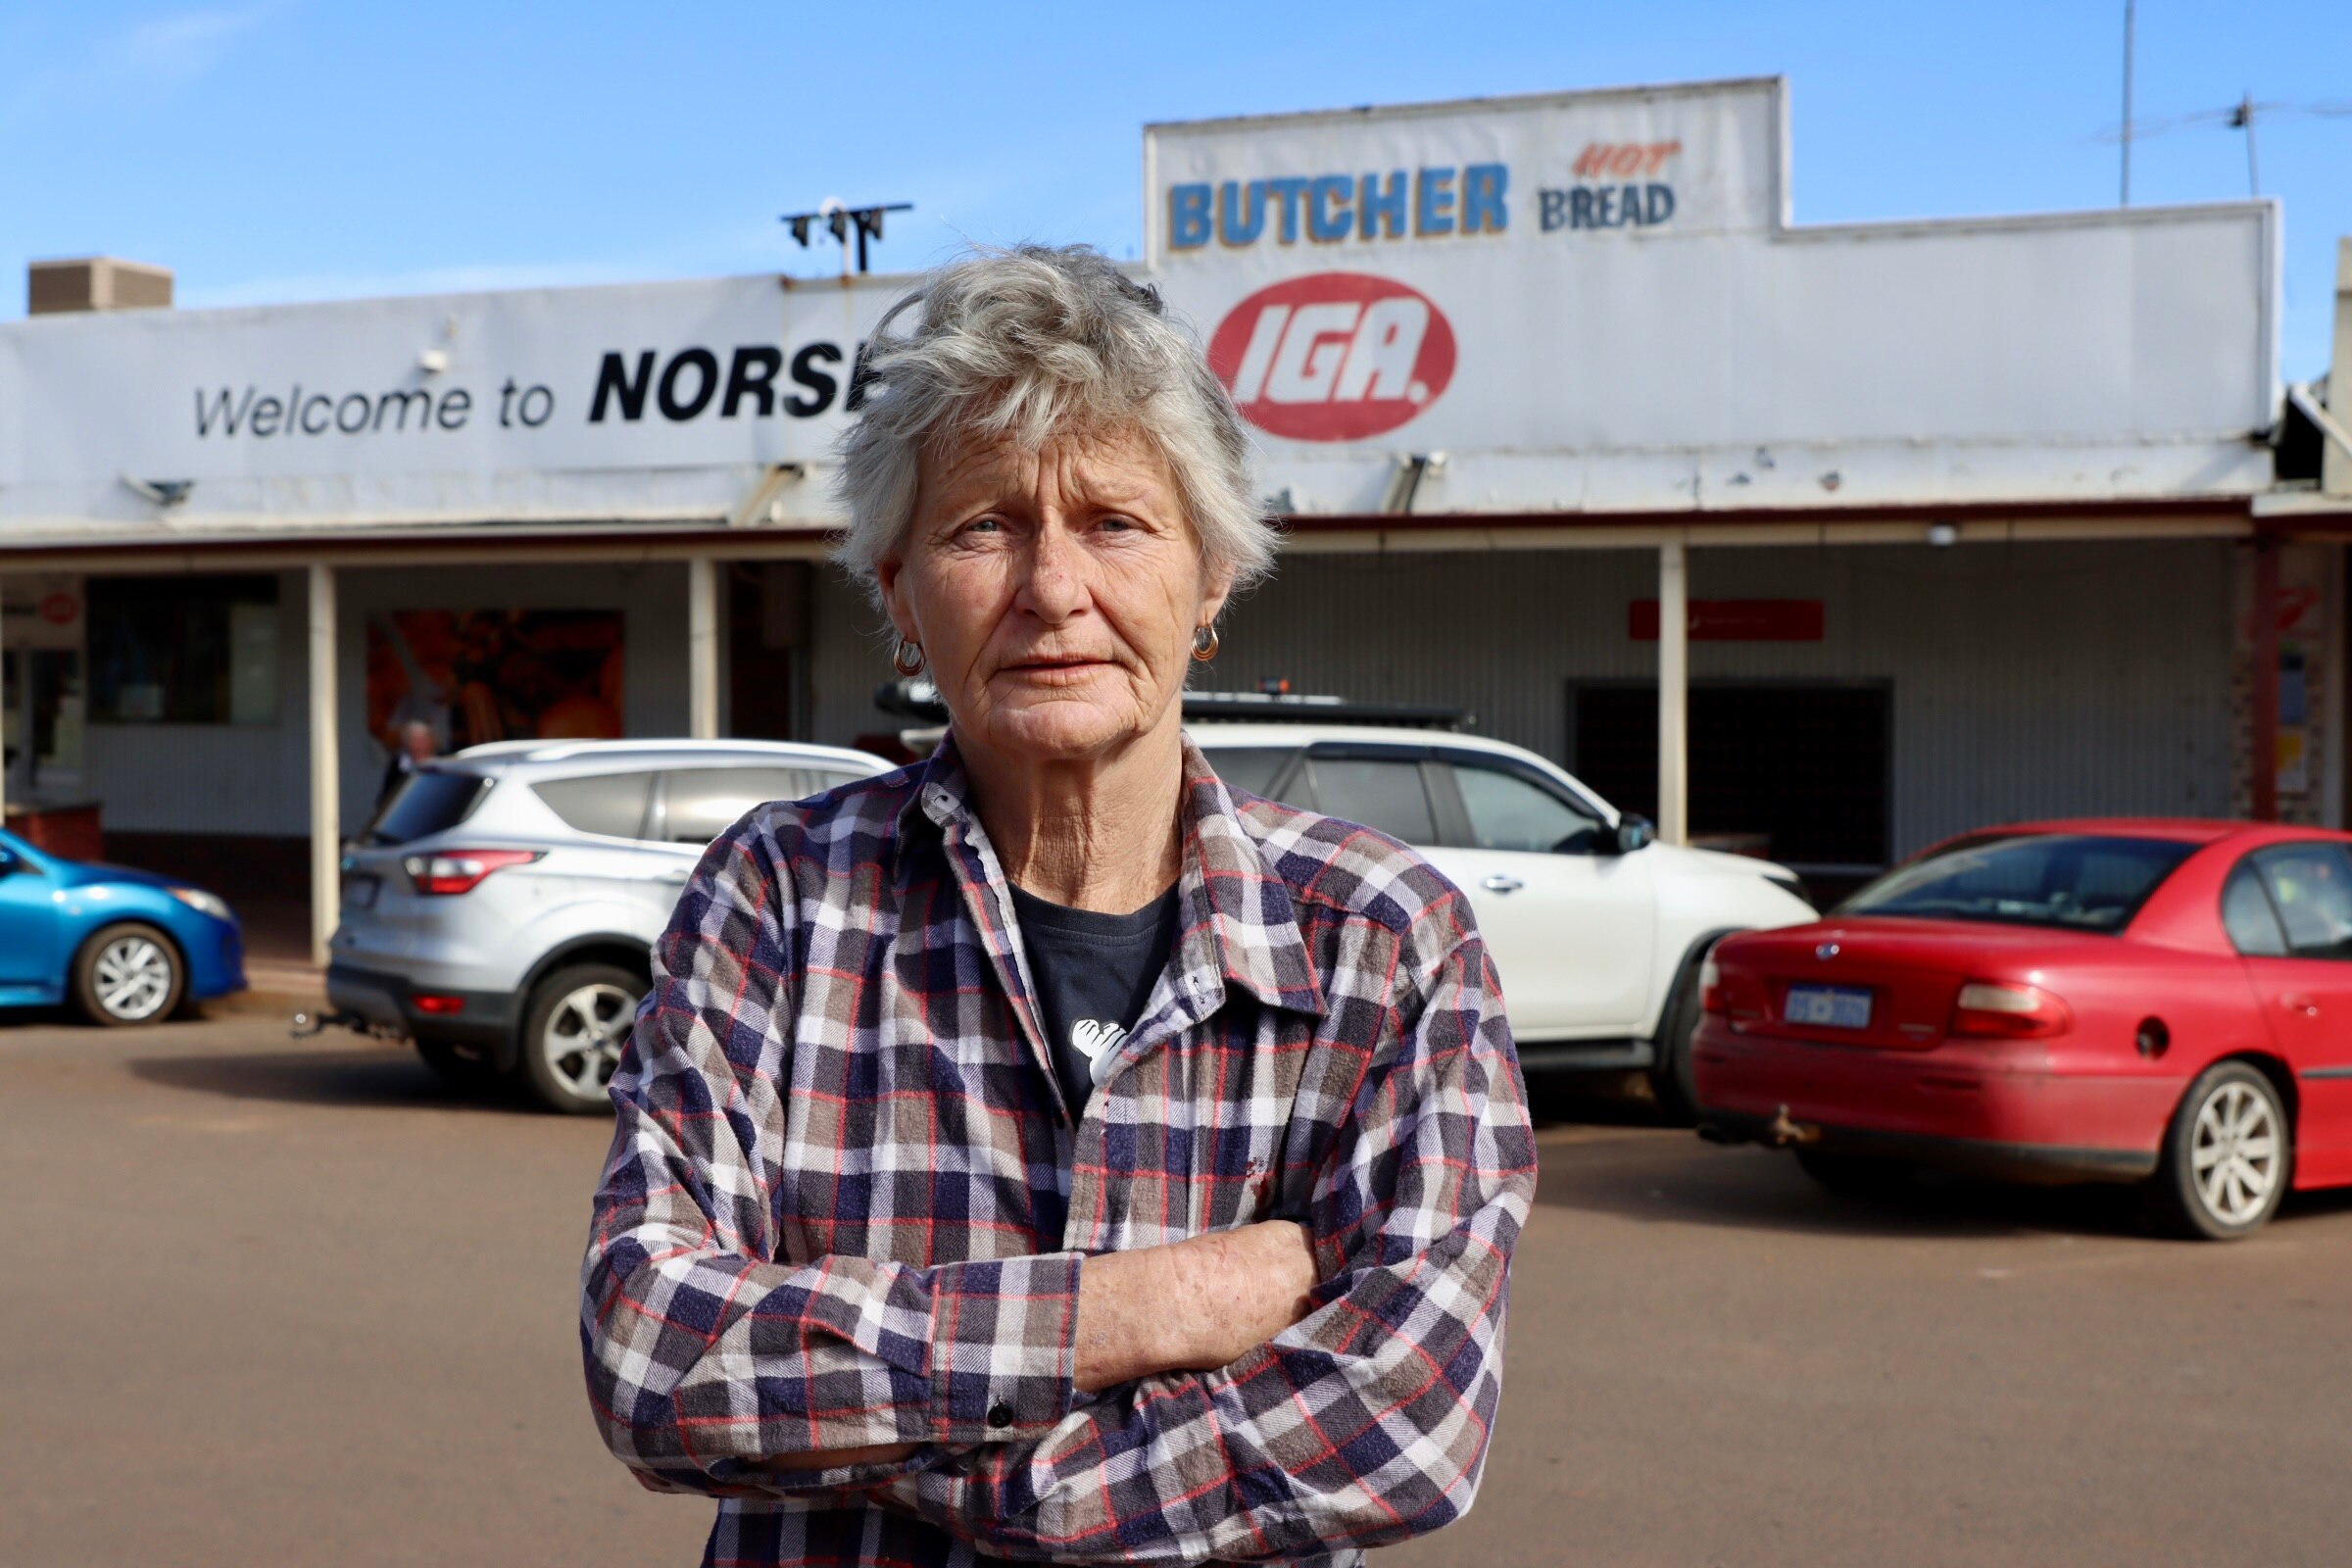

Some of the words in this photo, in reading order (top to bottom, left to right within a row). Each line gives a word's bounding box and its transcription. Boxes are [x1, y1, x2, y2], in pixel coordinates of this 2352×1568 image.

[1572, 139, 1683, 179] HOT
[1167, 163, 1509, 252] BUTCHER
[1538, 182, 1676, 233] BREAD
[195, 383, 472, 437] Welcome
[500, 375, 554, 428] to
